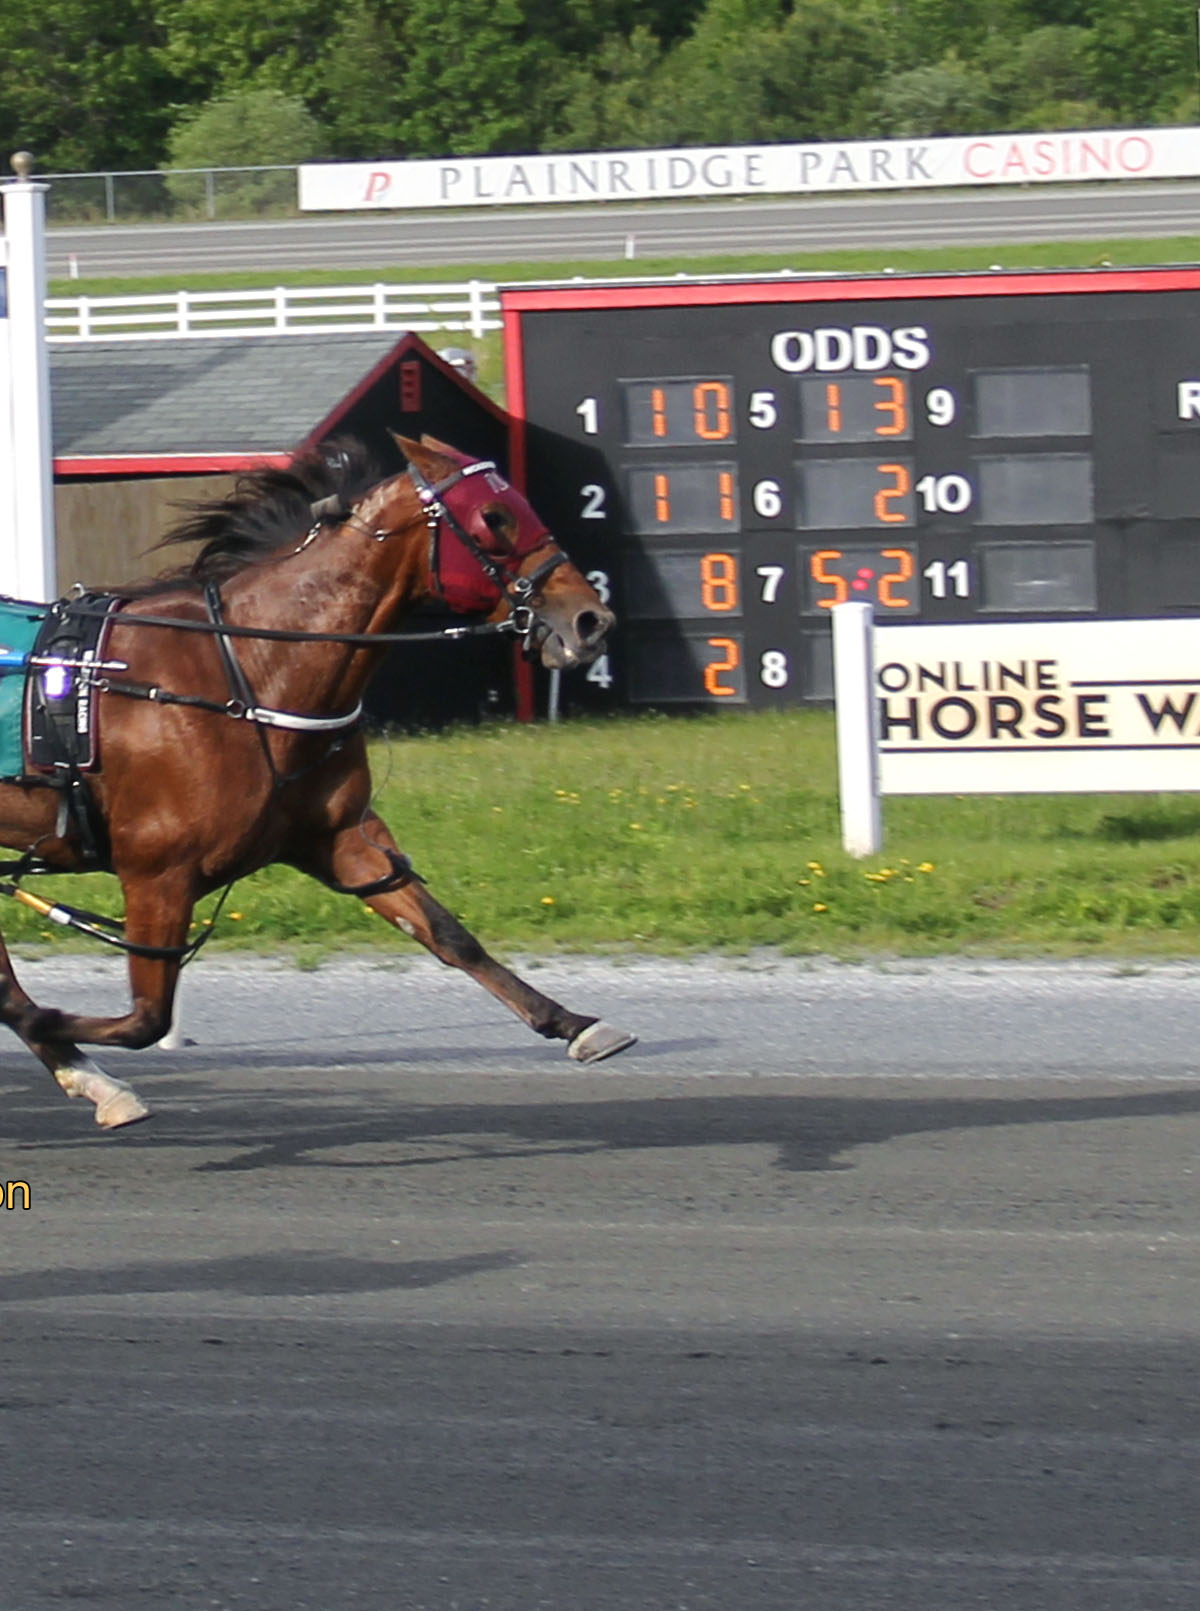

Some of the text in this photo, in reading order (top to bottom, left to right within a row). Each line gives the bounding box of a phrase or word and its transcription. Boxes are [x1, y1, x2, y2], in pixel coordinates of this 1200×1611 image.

[439, 136, 1155, 199] PLAINRIDGE PARK CASINO
[771, 326, 930, 372] ODDS
[575, 376, 955, 440] 1 10 5 13 9
[580, 463, 972, 522] 2 11 6 2 10
[586, 570, 610, 604] 3
[700, 553, 738, 611] 8
[756, 565, 784, 602] 7
[923, 560, 969, 598] 11
[586, 637, 788, 695] 4 2 8
[878, 660, 1059, 692] ONLINE
[879, 693, 1112, 740] HORSE
